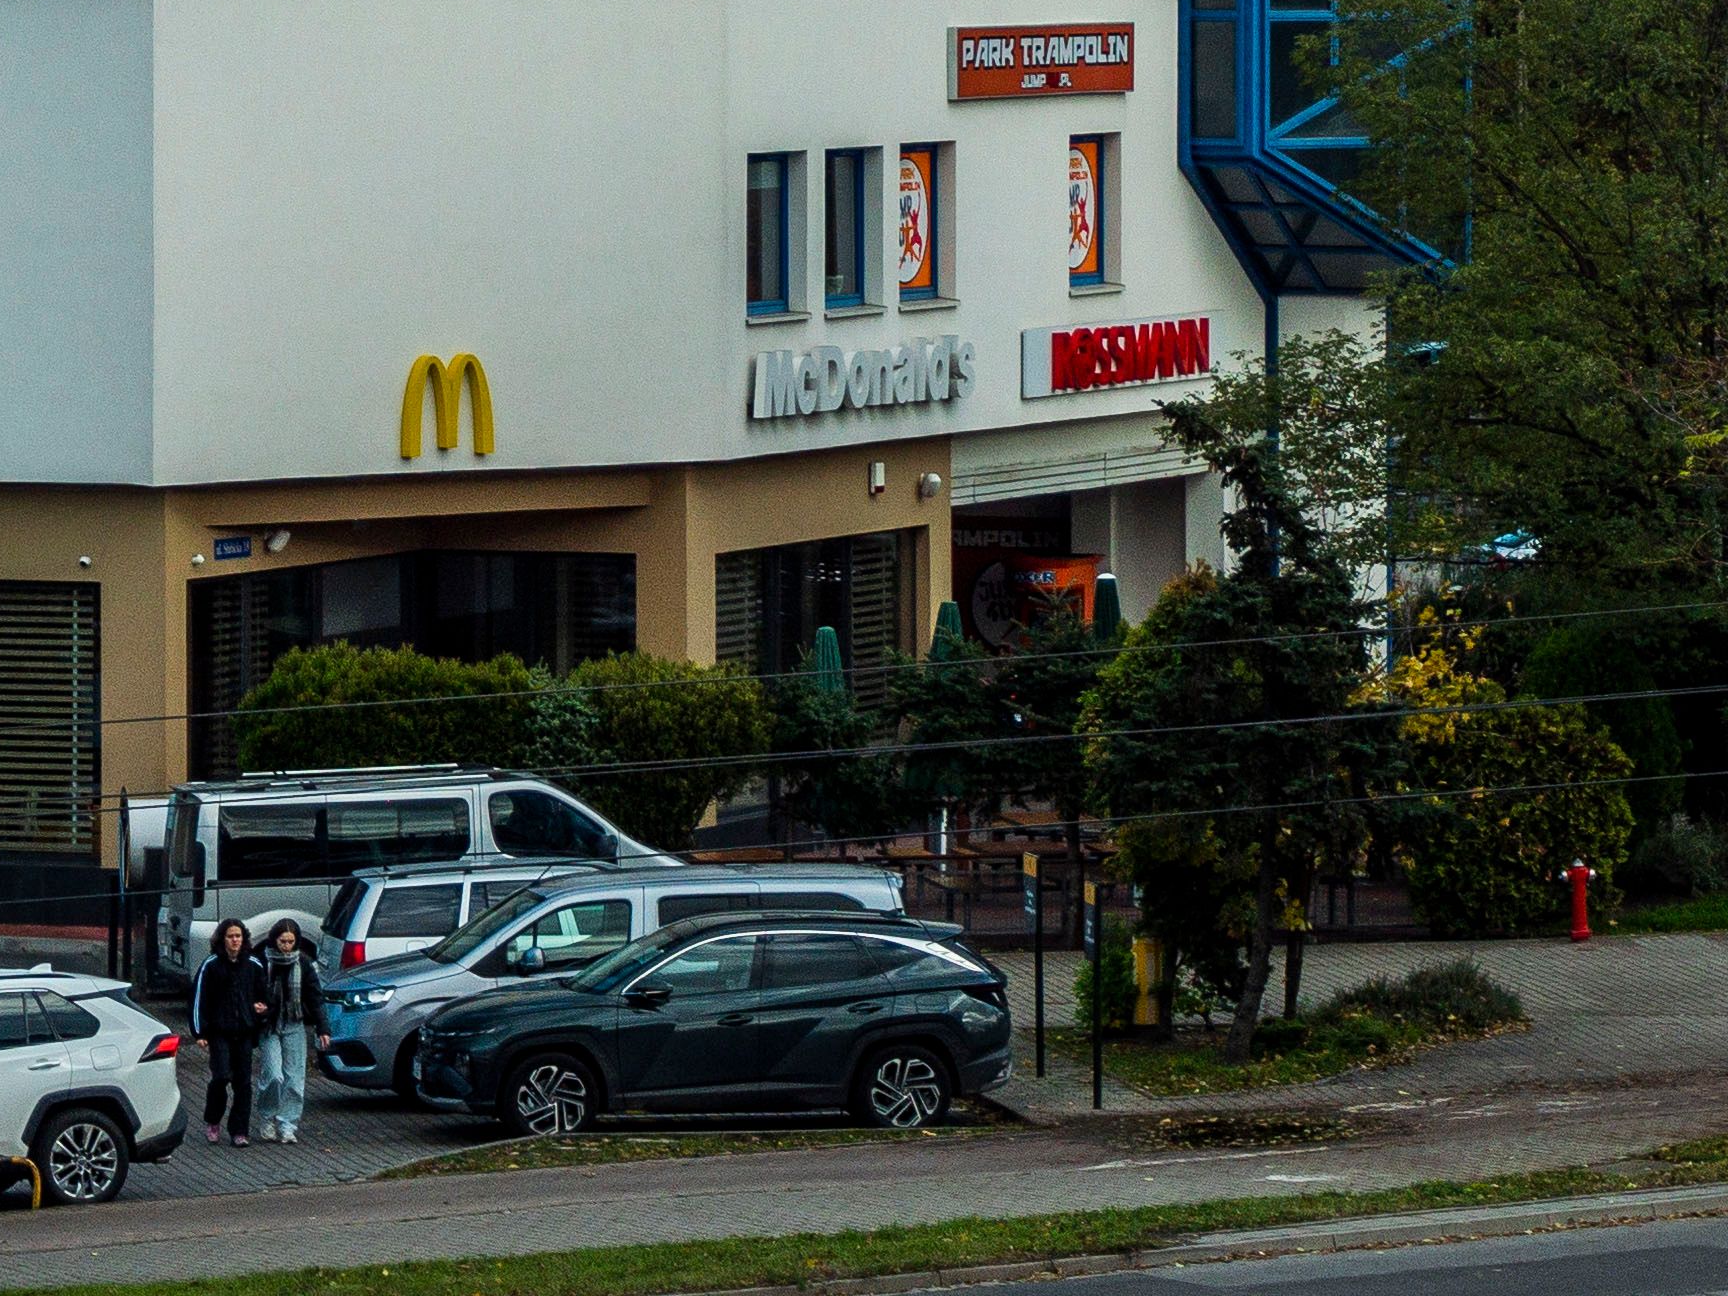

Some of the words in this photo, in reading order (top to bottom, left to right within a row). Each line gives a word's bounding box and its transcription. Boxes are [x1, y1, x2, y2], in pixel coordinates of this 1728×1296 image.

[962, 37, 1014, 69] PARK
[1020, 34, 1129, 66] TRAMPOLIN
[754, 333, 975, 419] McDonald's
[1051, 318, 1210, 392] ROSSMANN
